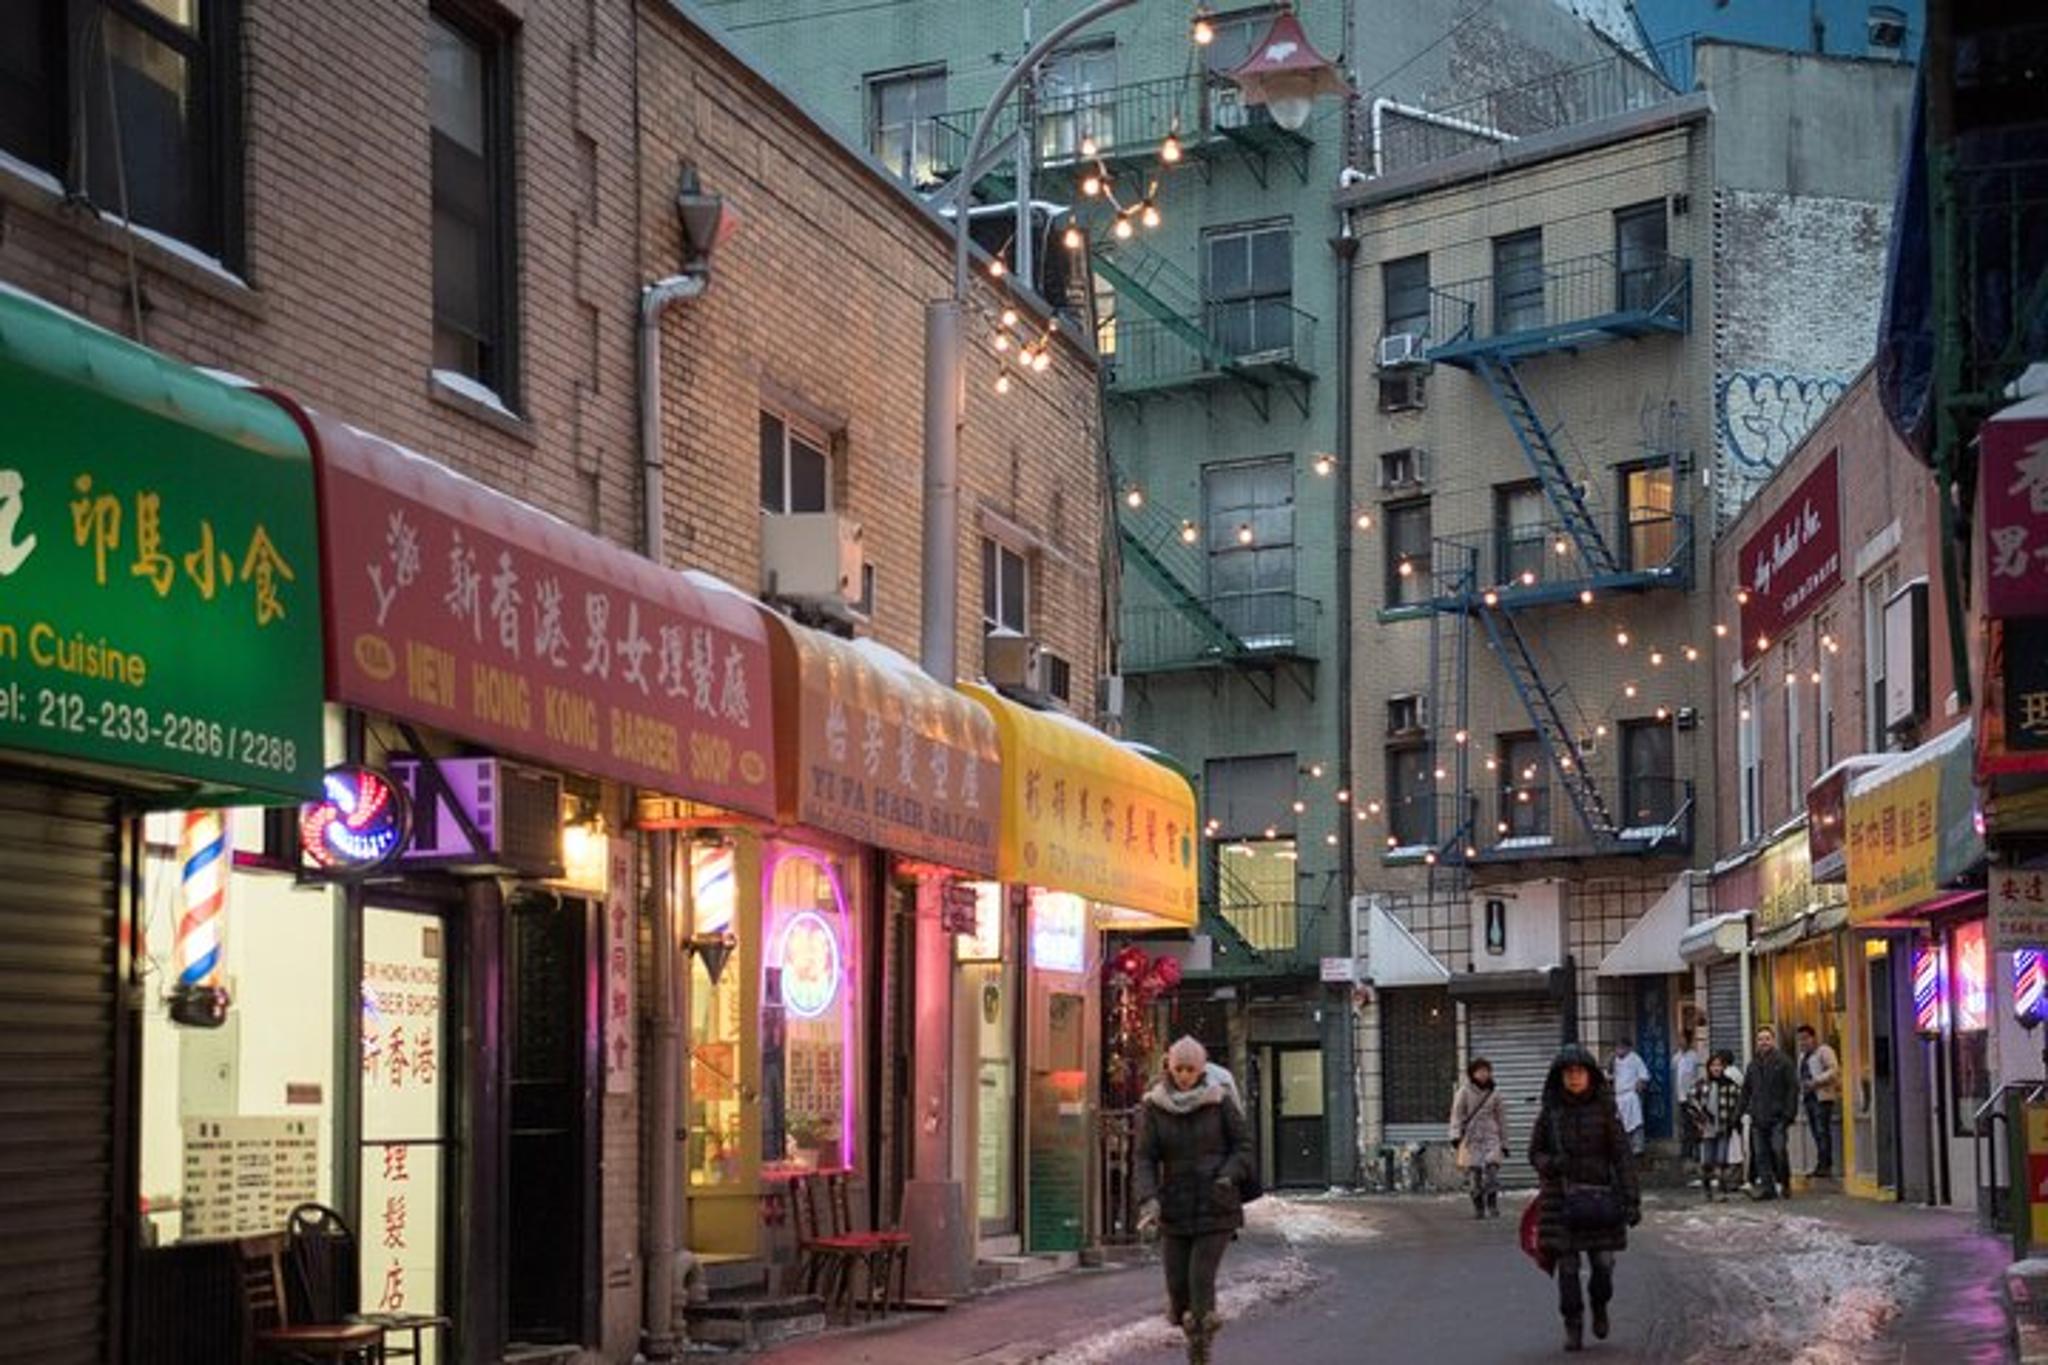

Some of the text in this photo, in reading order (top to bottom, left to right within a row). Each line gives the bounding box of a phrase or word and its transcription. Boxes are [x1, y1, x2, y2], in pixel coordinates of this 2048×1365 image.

[70, 473, 295, 626] 印馬小食
[29, 622, 147, 687] Cuisine
[406, 639, 456, 710] NEW
[472, 663, 530, 732] HONG
[546, 686, 599, 752] KONG
[611, 707, 680, 775] BARBER
[690, 731, 734, 785] SHOP
[874, 786, 924, 830] HAIR
[929, 805, 992, 848] SALON
